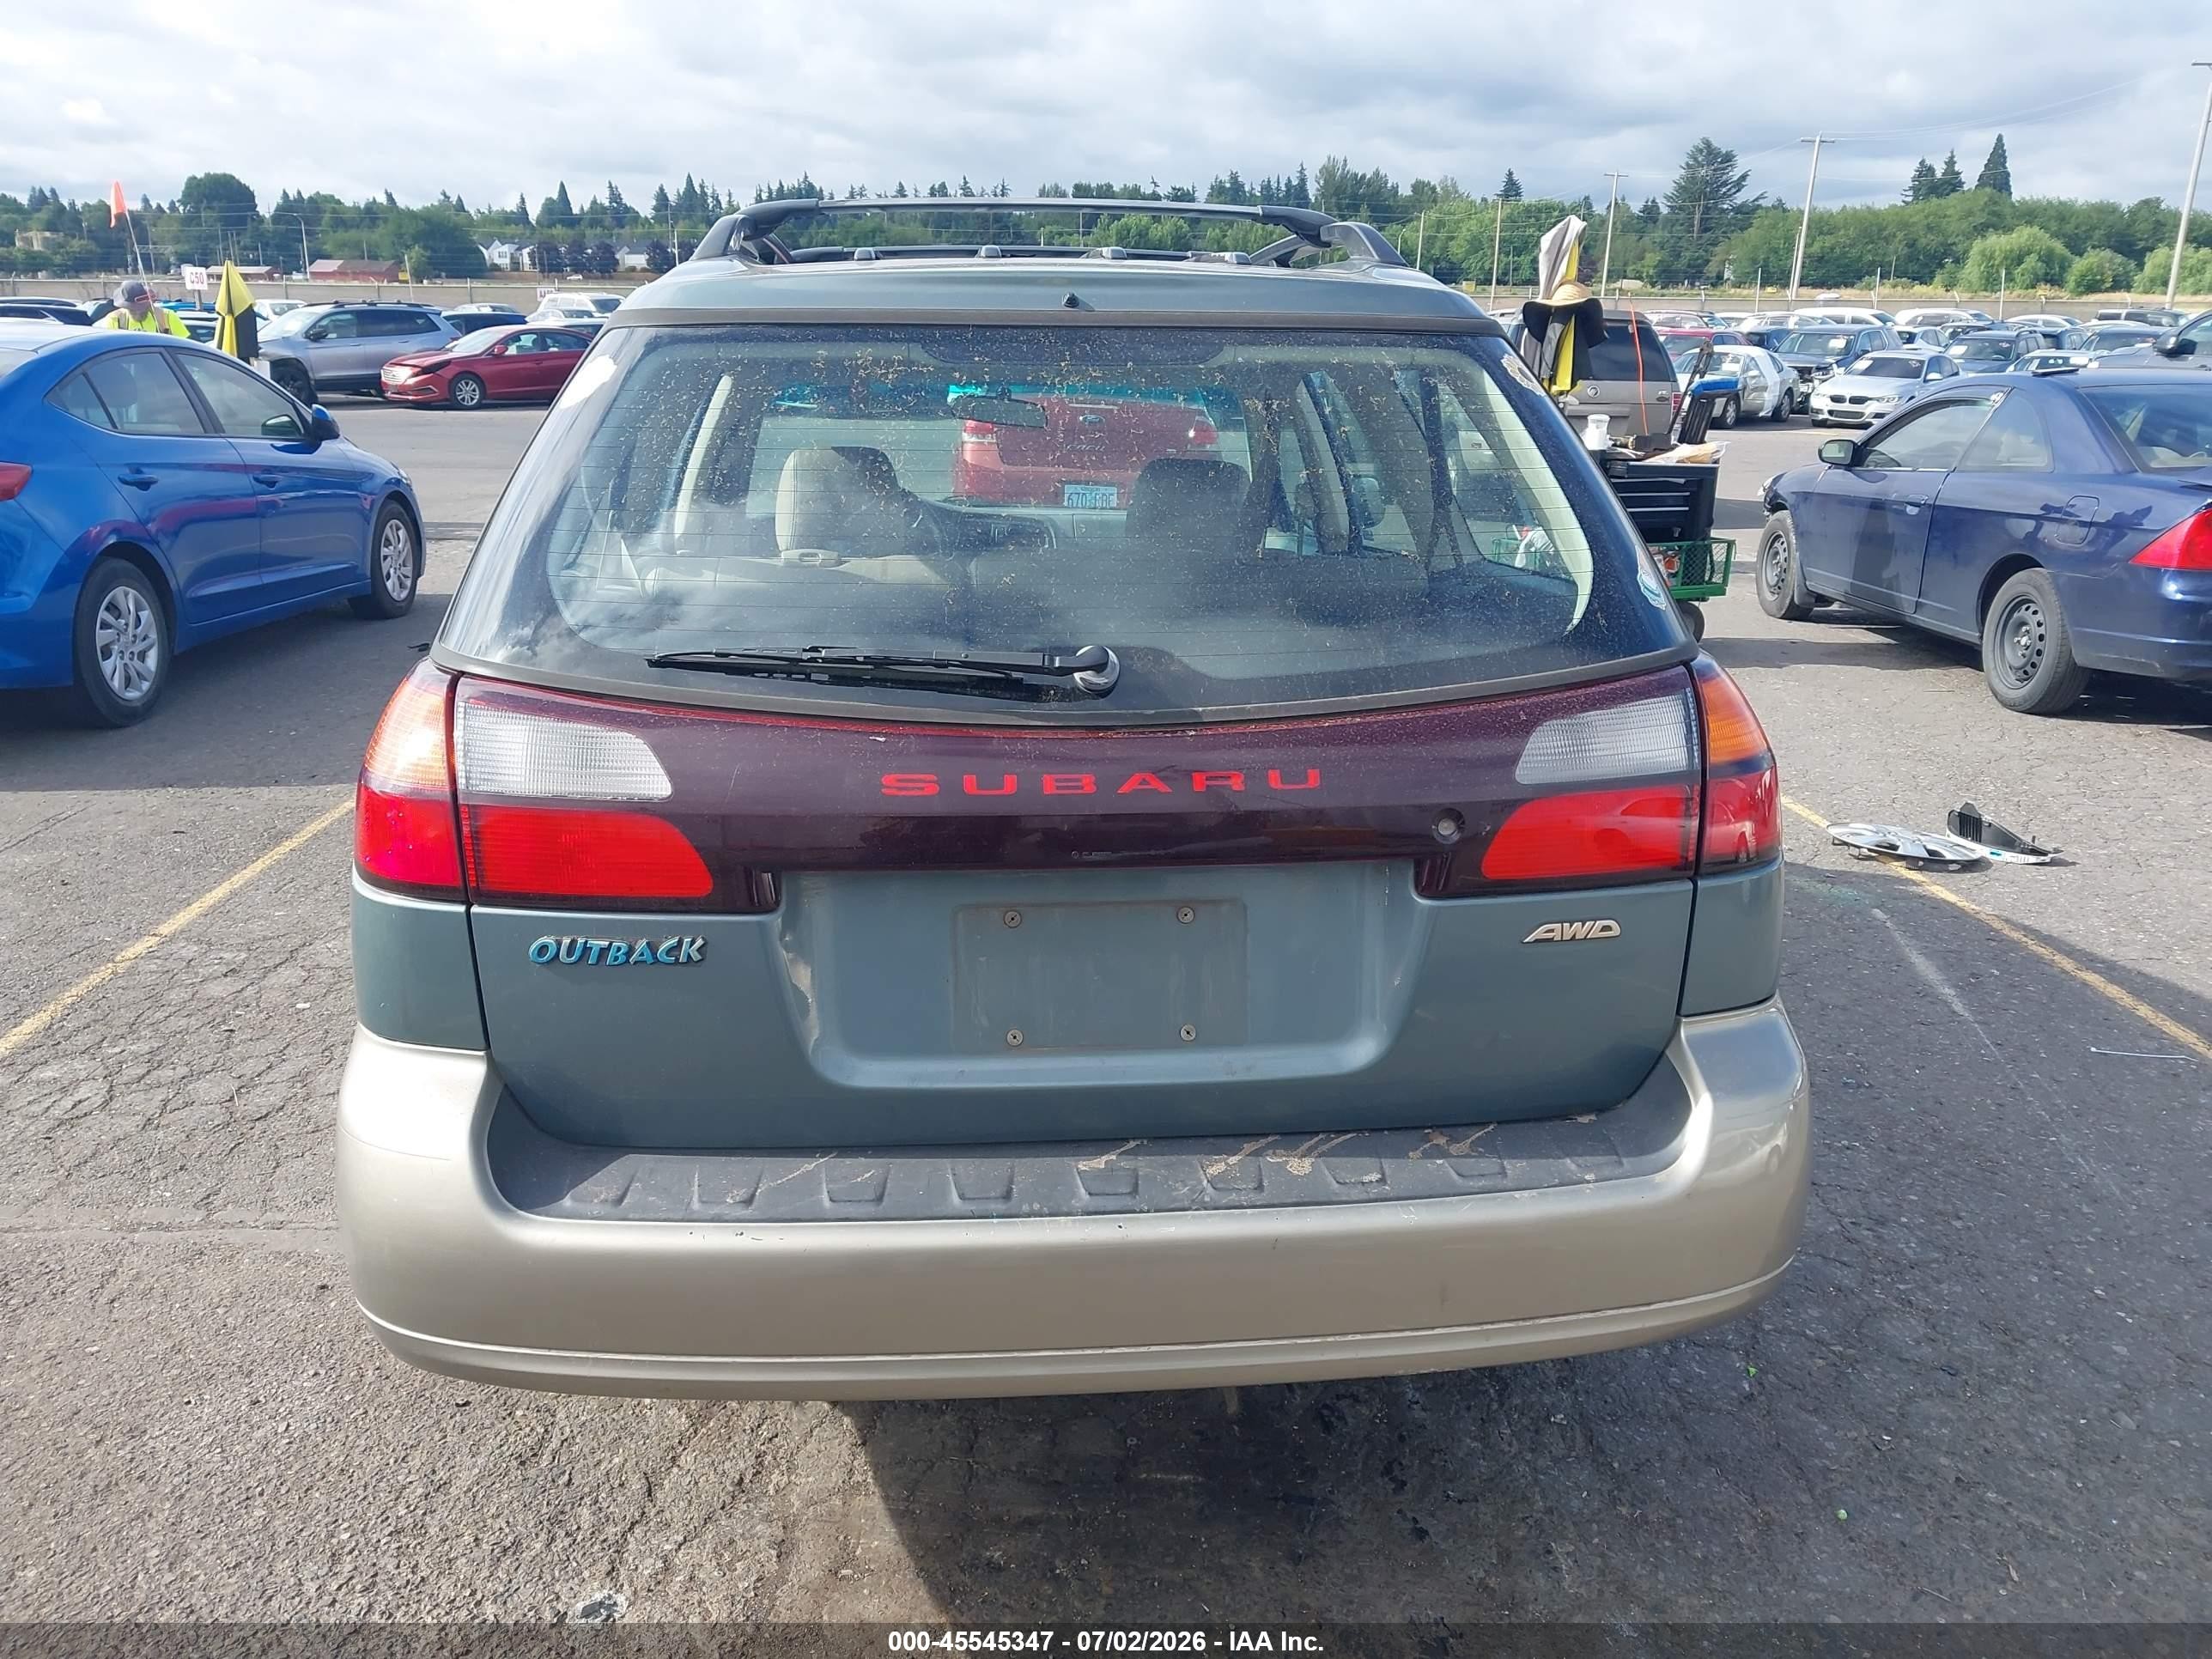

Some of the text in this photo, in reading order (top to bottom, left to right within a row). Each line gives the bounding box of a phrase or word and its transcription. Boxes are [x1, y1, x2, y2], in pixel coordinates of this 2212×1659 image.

[880, 769, 1321, 796] SUBARU
[1522, 919, 1621, 944] AWD
[528, 935, 708, 966] OUTBACK
